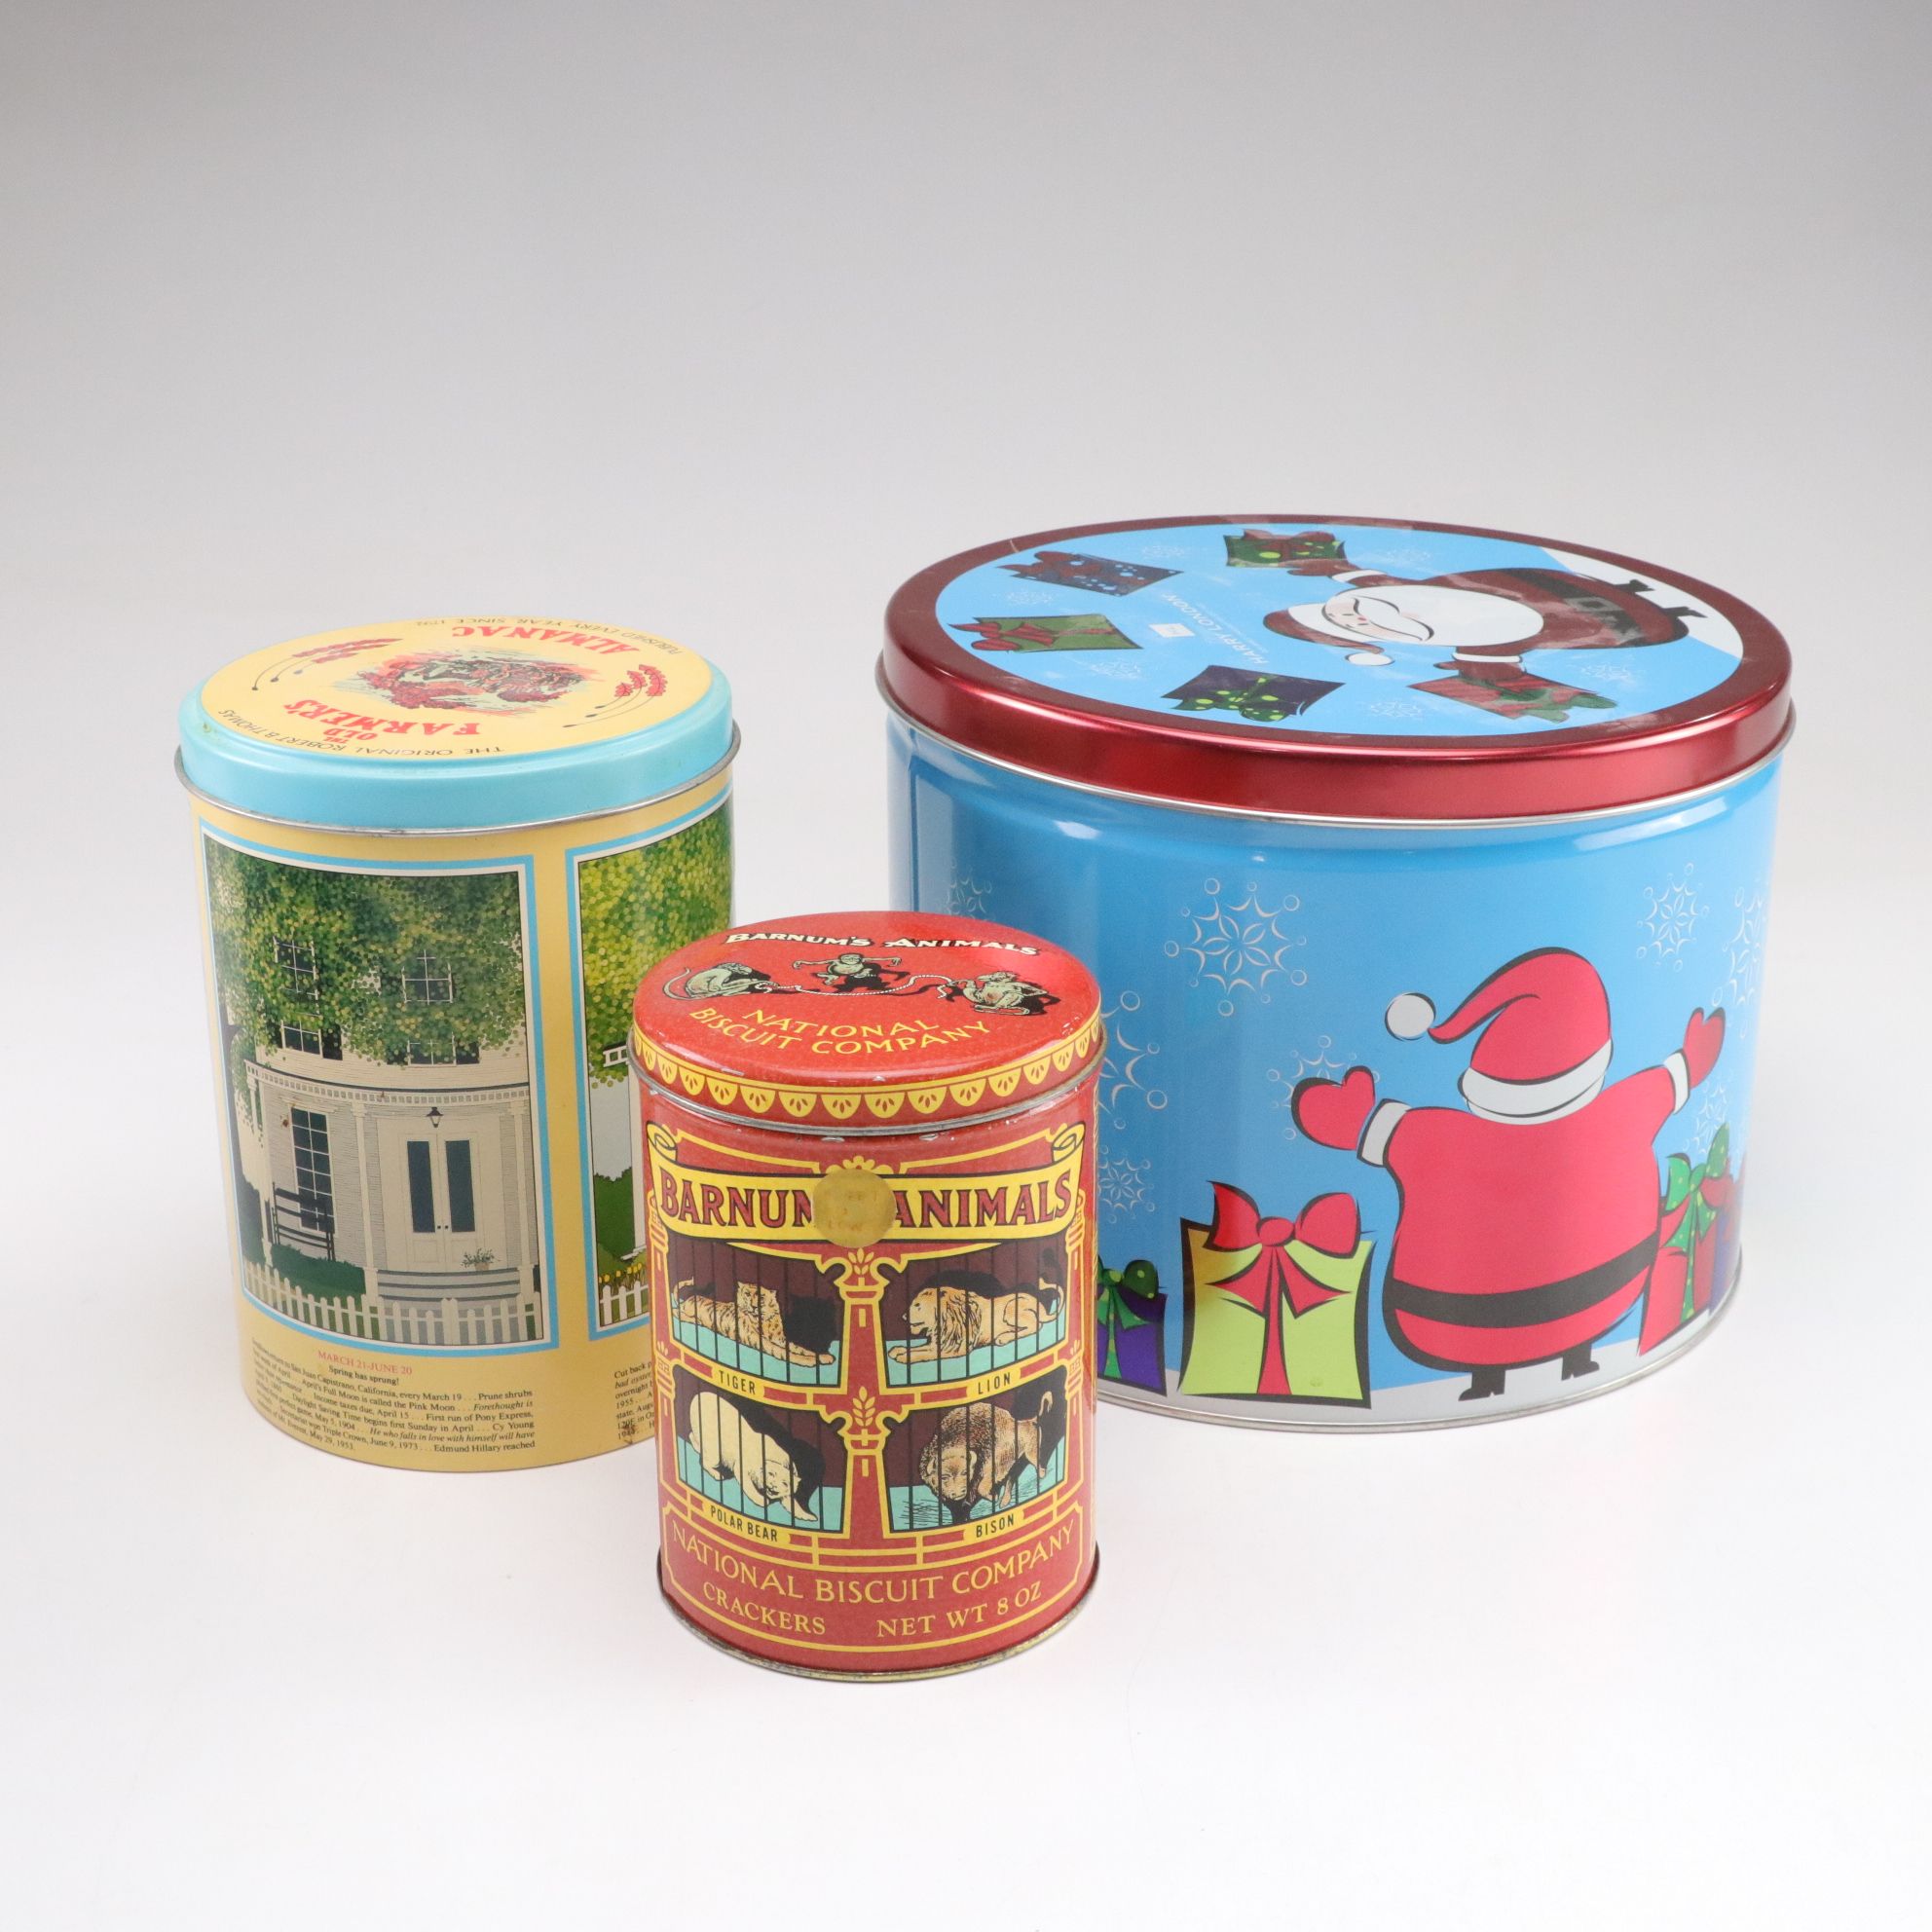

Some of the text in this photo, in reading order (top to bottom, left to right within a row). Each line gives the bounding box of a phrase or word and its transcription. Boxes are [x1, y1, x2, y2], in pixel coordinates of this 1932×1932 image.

[1161, 592, 1222, 631] LONDON
[452, 626, 640, 654] ALMANAC
[1215, 633, 1269, 664] HARRY
[218, 709, 267, 734] THOMAS
[283, 699, 480, 735] FARMER'S
[276, 736, 347, 751] ROBERT
[322, 727, 378, 740] OLD
[355, 747, 454, 756] ORIGINAL
[725, 932, 1040, 956] BARNUM'S ANIMALS
[688, 1007, 990, 1053] BISCUIT COMPANY
[742, 1009, 940, 1037] NATIONAL
[318, 1351, 353, 1365] MARCH
[401, 1366, 412, 1375] 20
[329, 1364, 399, 1386] Spring has sprung!
[614, 1368, 628, 1379] Cut
[630, 1361, 646, 1373] back
[357, 1384, 398, 1398] California,
[399, 1393, 421, 1402] every
[423, 1392, 450, 1401] March
[504, 1389, 533, 1399] shrubs
[615, 1383, 648, 1399] overnight
[719, 1370, 757, 1394] TIGER
[978, 1371, 1011, 1395] LION
[323, 1386, 336, 1396] Full
[338, 1390, 359, 1400] Moon
[369, 1396, 391, 1407] called
[394, 1400, 406, 1409] the
[409, 1401, 427, 1410] Pink
[430, 1402, 455, 1411] Moon
[473, 1400, 523, 1412] Forethought
[343, 1411, 361, 1422] Time
[363, 1416, 388, 1428] begins
[408, 1422, 437, 1432] Sunday
[452, 1425, 474, 1433] April
[493, 1423, 504, 1431] Cy
[508, 1421, 535, 1430] Young
[377, 1407, 396, 1418] April
[427, 1413, 444, 1422] First
[475, 1413, 496, 1423] Pony
[310, 1430, 323, 1442] May
[315, 1413, 328, 1424] May
[466, 1431, 498, 1442] himself
[500, 1431, 513, 1440] will
[516, 1430, 535, 1439] have
[322, 1425, 341, 1436] Triple
[370, 1437, 388, 1447] June
[434, 1443, 468, 1453] Edmund
[472, 1442, 501, 1453] Hillary
[503, 1439, 535, 1450] reached
[710, 1505, 778, 1542] POLAR BEAR
[976, 1512, 1015, 1539] BISON
[672, 1518, 1074, 1604] NATIONAL BISCUIT COMPANY
[703, 1580, 1042, 1638] CRACKERS NET WT 8 OZ
